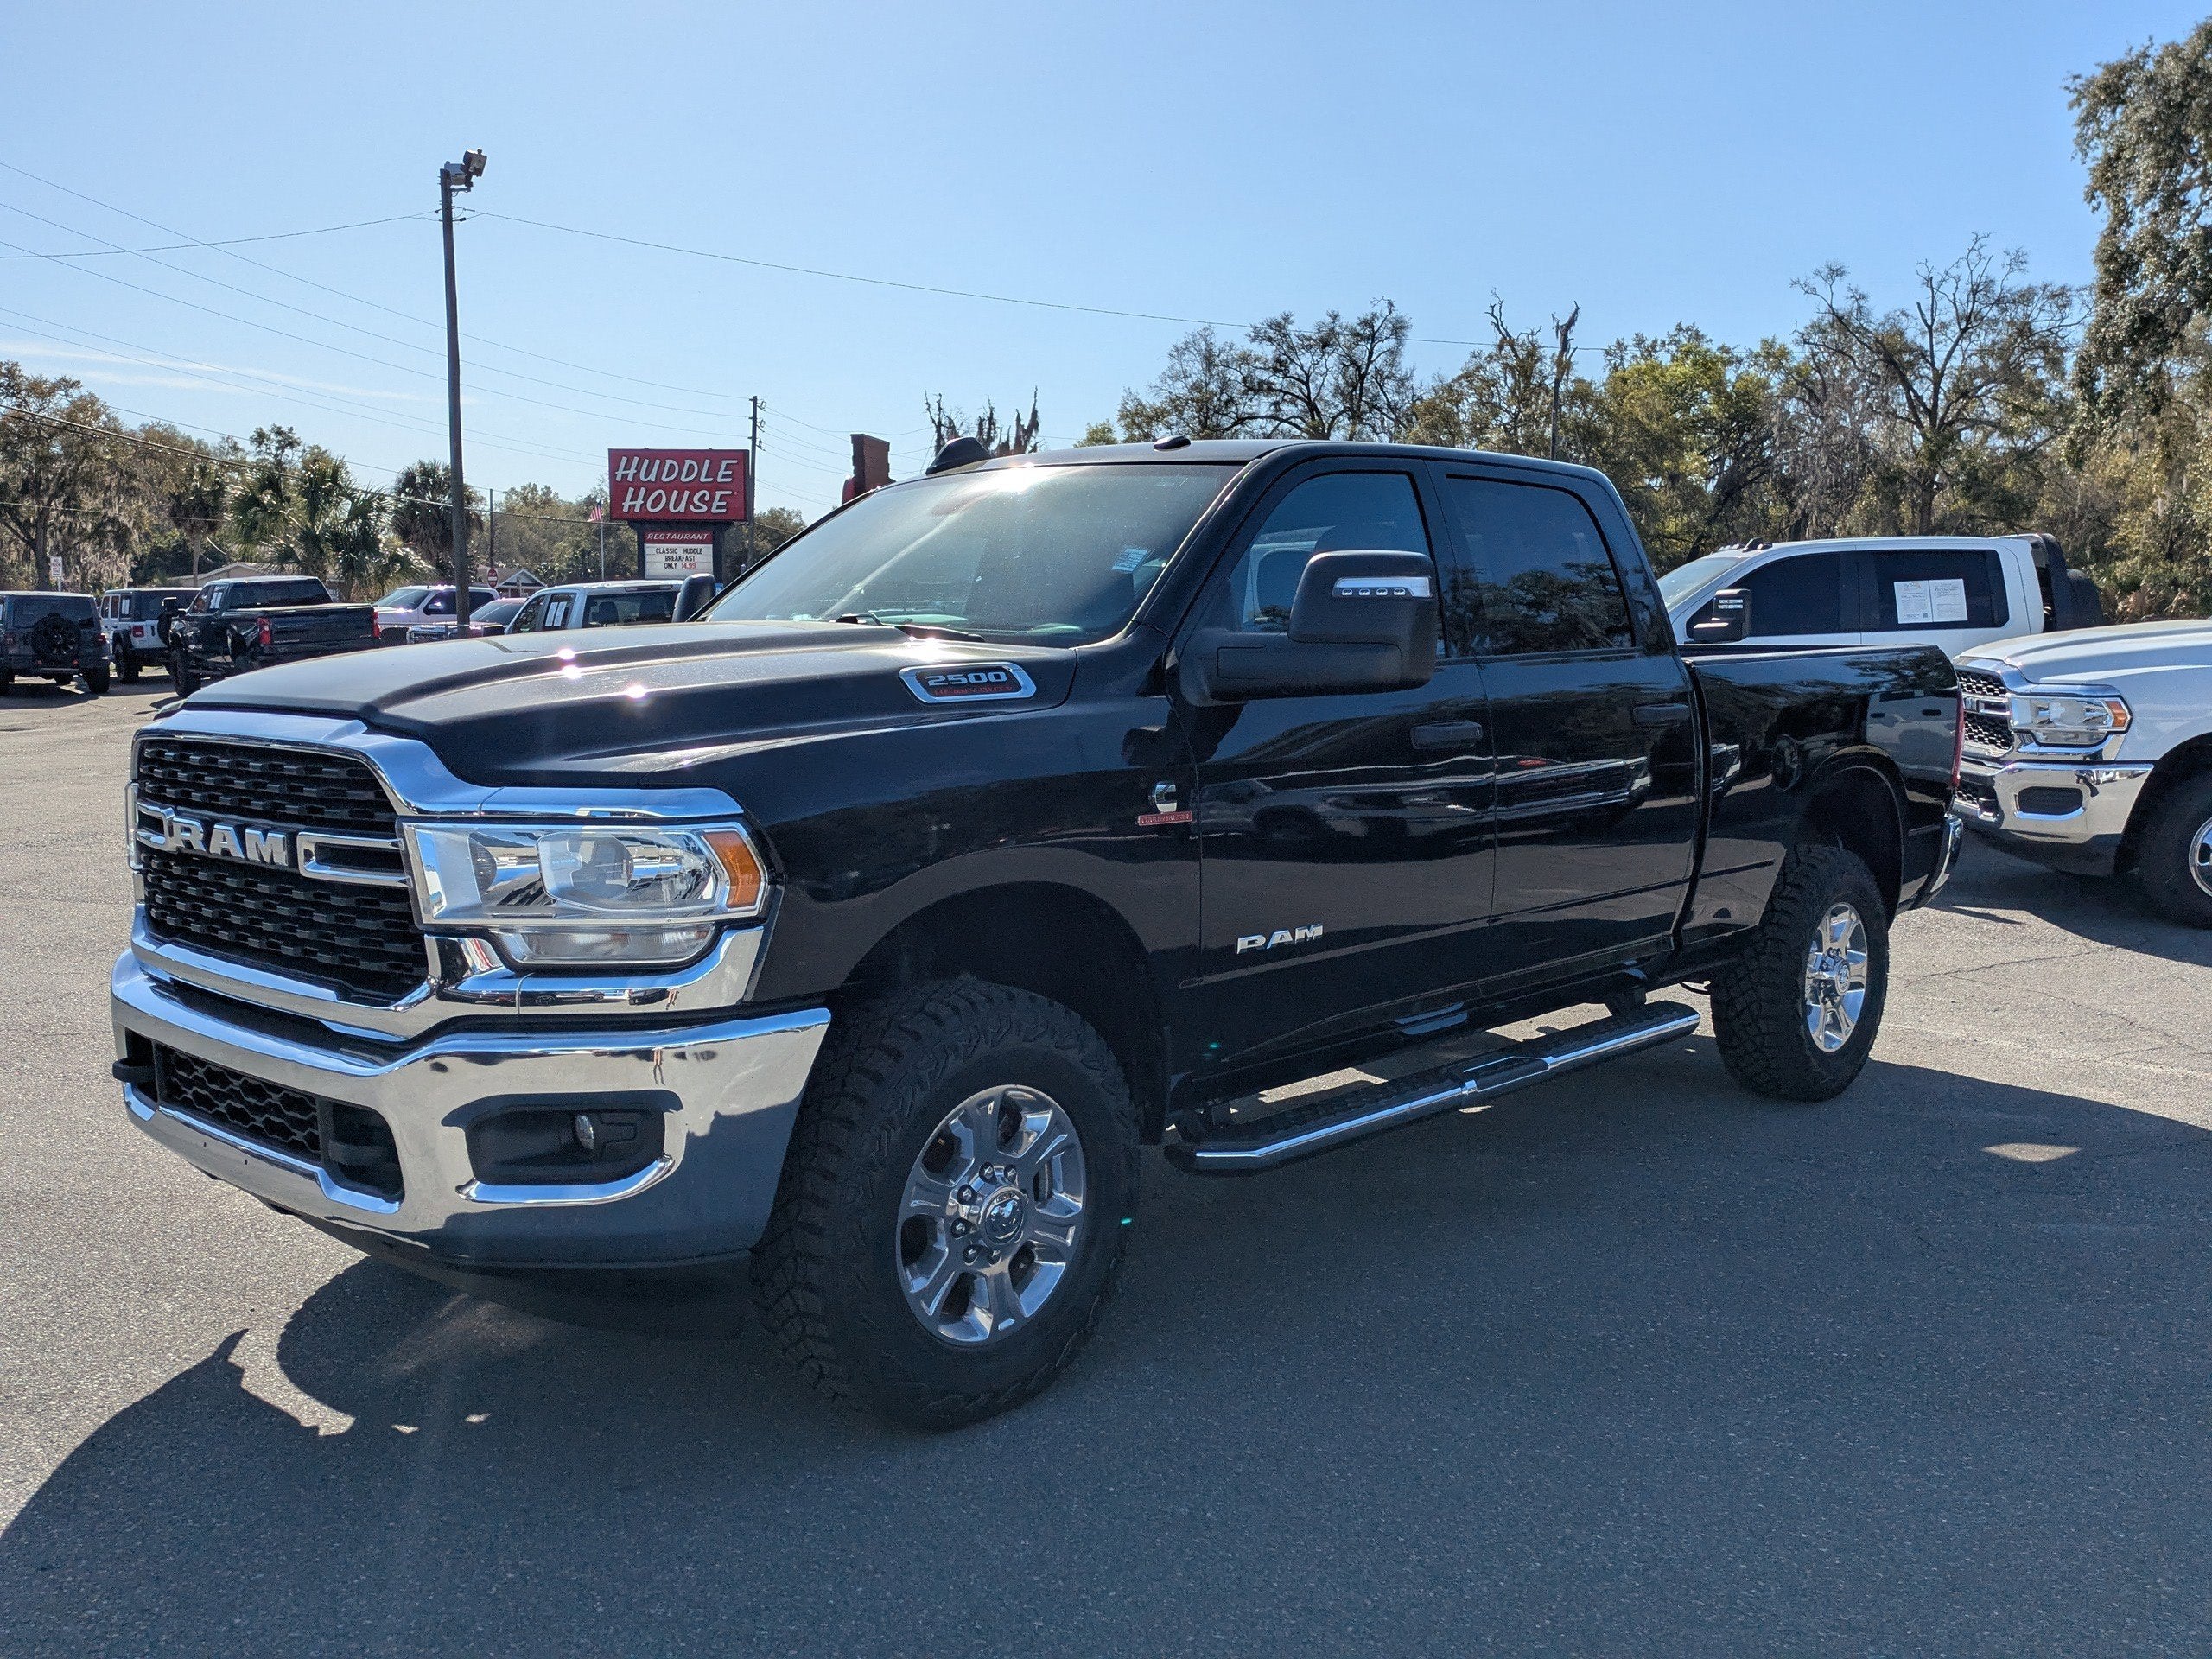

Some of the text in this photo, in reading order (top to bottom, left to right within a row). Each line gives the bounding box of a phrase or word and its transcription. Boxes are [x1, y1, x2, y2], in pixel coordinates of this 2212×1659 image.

[615, 456, 738, 483] HUDDLE
[622, 486, 732, 513] HOUSE
[925, 671, 1007, 687] 2500
[171, 817, 289, 866] RAM
[1236, 923, 1324, 955] RAM
